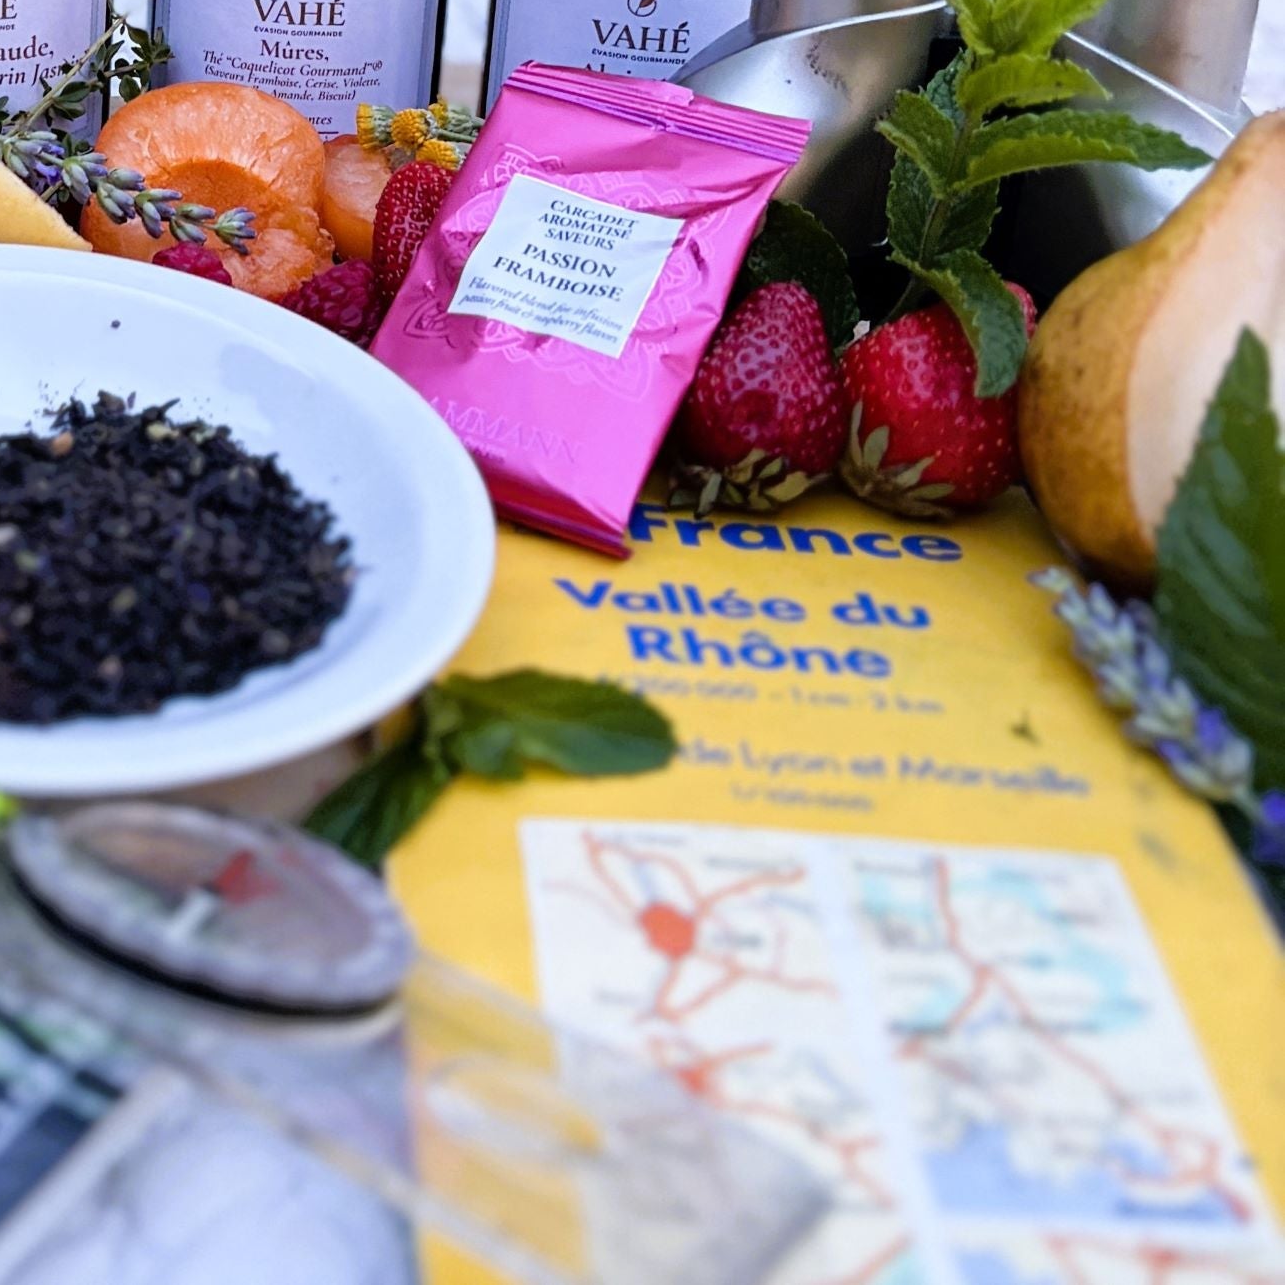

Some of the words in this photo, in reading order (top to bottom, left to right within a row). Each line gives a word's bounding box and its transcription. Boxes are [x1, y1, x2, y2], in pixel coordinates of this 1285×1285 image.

[260, 39, 329, 62] Mûres,
[592, 19, 690, 54] VAHÉ
[203, 50, 224, 65] Thé
[592, 48, 628, 60] ÉVASION
[205, 65, 245, 82] (Saveurs
[248, 74, 302, 88] Framboise,
[305, 78, 338, 89] Cerise,
[318, 91, 355, 101] Biscuit)
[550, 200, 638, 229] CARCADET
[545, 228, 615, 251] SAVEURS
[522, 243, 617, 279] PASSION
[493, 256, 624, 302] FRAMBOISE
[627, 502, 964, 562] France
[553, 577, 808, 624] Vallée
[831, 590, 932, 631] du
[625, 623, 893, 679] Rhône
